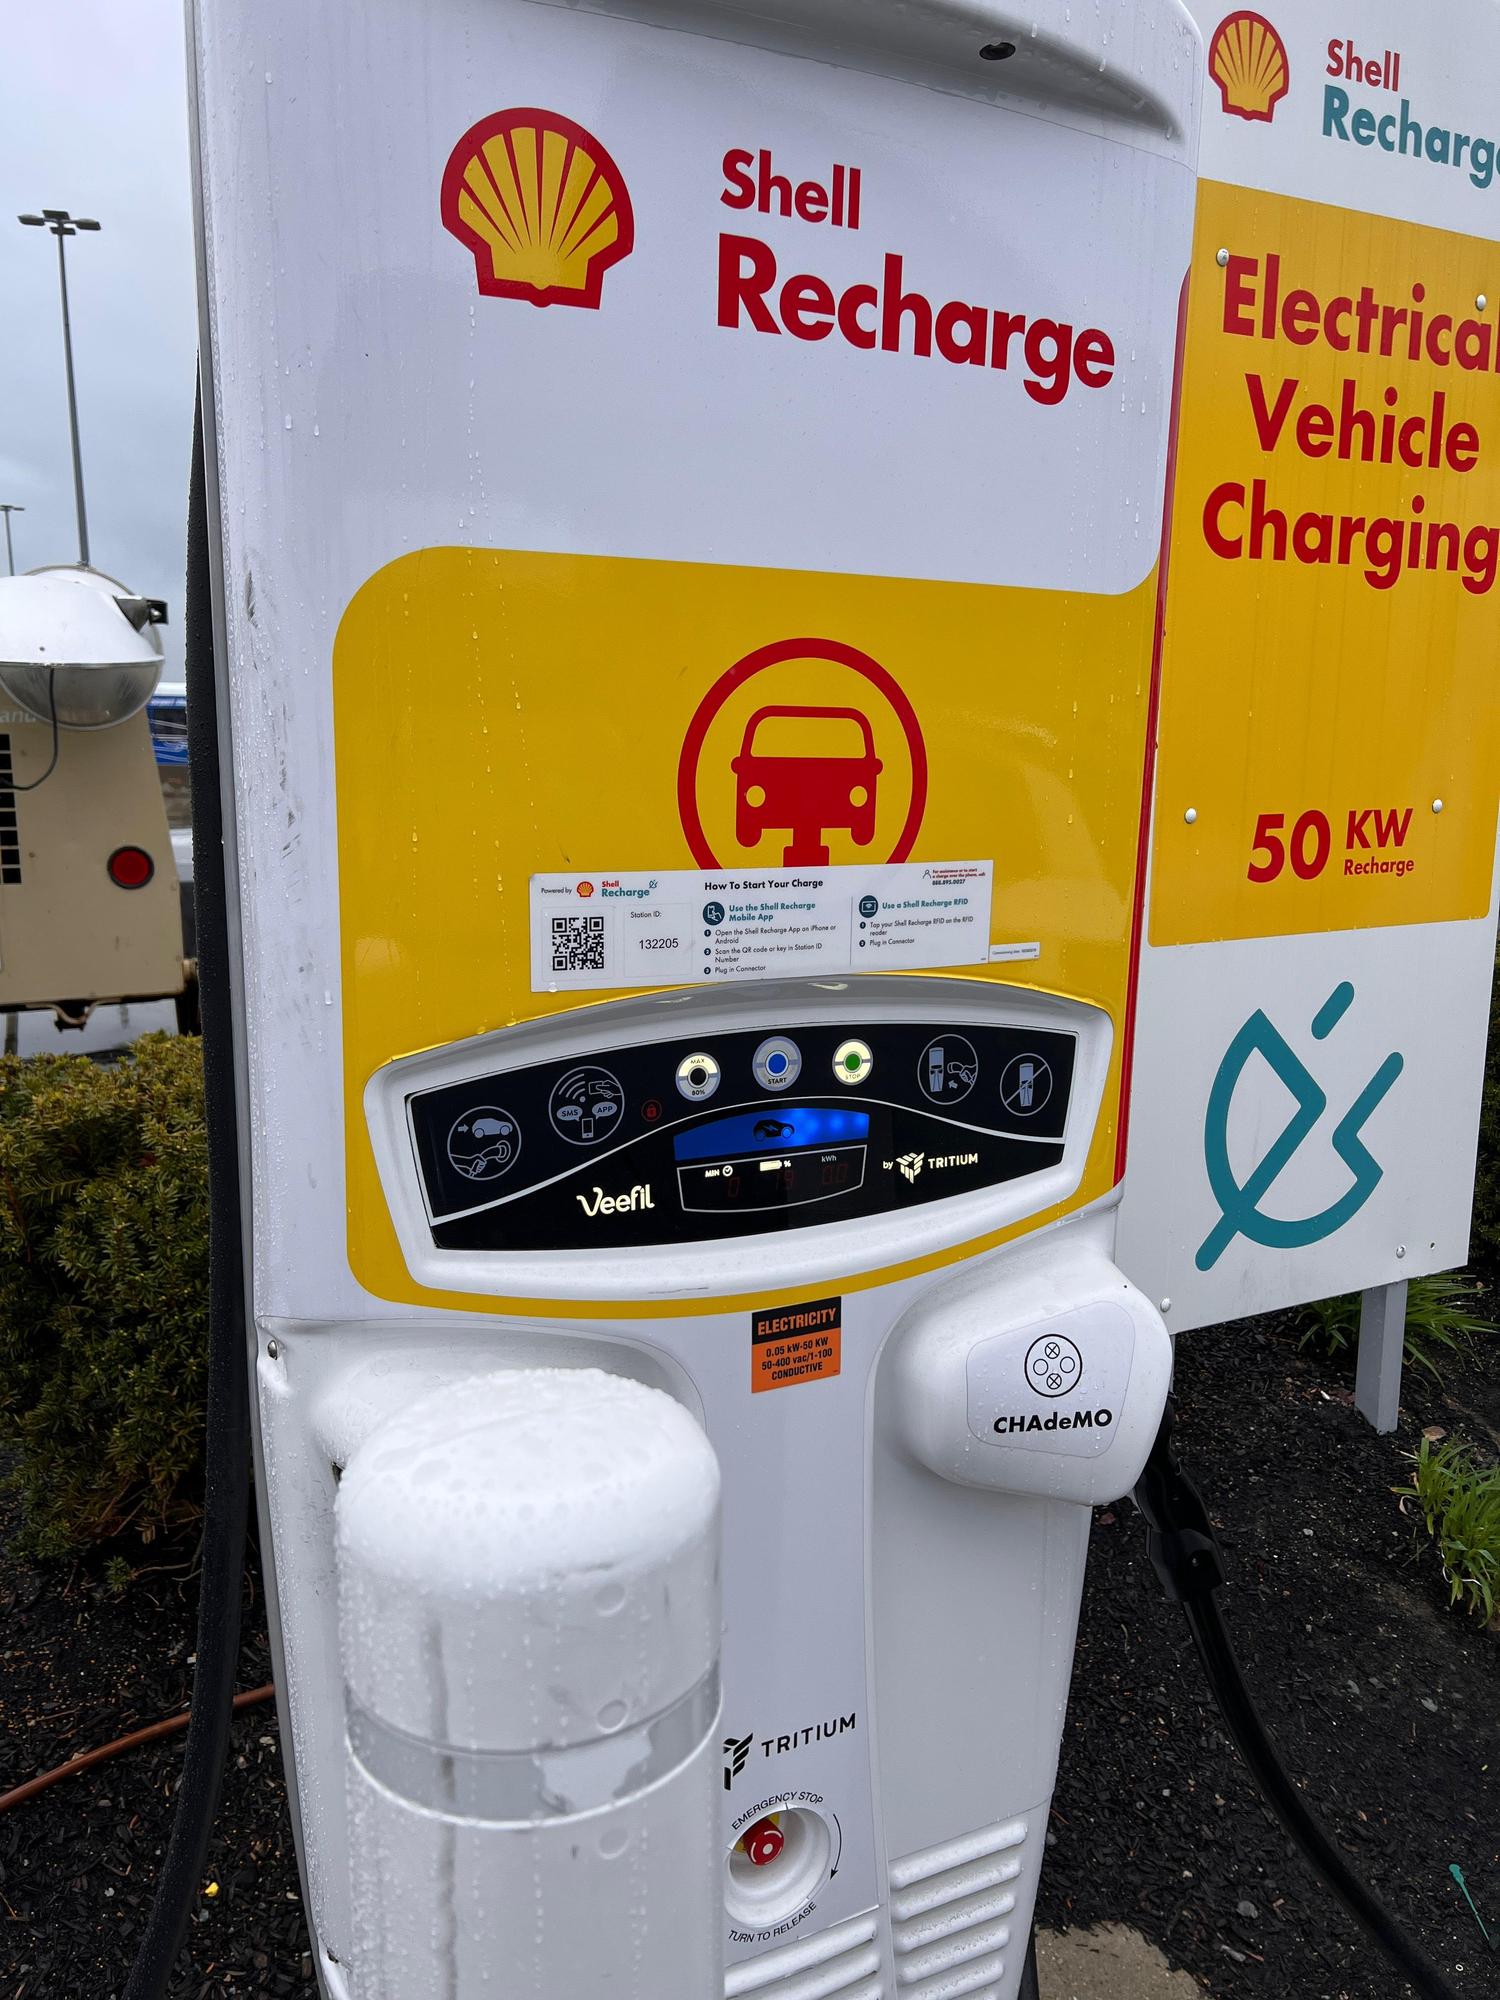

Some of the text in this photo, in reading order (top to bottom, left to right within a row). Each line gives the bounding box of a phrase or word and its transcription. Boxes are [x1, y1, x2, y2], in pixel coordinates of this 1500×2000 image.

[1326, 38, 1400, 92] Shell
[1322, 84, 1500, 190] Recharg
[720, 148, 861, 230] Shell
[717, 232, 1115, 406] Recharge
[1244, 372, 1479, 473] Vehicle
[1202, 478, 1500, 595] Charging
[1247, 807, 1414, 883] 50 KW
[1343, 855, 1415, 877] Recharge
[704, 878, 824, 891] How To Start Your Charge
[541, 887, 562, 895] Powered
[601, 888, 650, 899] Recharge
[760, 903, 778, 911] Shell
[780, 902, 816, 911] Recharge
[882, 902, 896, 910] Use
[902, 901, 920, 909] Shell
[920, 900, 952, 909] Recharge
[954, 898, 968, 906] RFID
[631, 910, 663, 918] Station ID:
[729, 913, 774, 924] Mobile App
[870, 922, 880, 930] Tap
[908, 919, 932, 928] Recharge
[715, 930, 732, 938] Open
[760, 927, 788, 936] Recharge
[788, 926, 800, 935] App
[640, 938, 679, 950] 132205
[870, 940, 881, 948] Plug
[888, 938, 914, 946] Connector
[715, 948, 730, 956] Scan
[752, 946, 768, 954] code
[776, 945, 786, 954] key
[794, 944, 814, 952] Station
[715, 966, 728, 975] Plug
[767, 1077, 787, 1085] START
[692, 1088, 706, 1096] 80%
[596, 1106, 613, 1114] APP
[784, 1160, 791, 1168] %
[822, 1154, 837, 1163] kWh
[928, 1152, 978, 1169] TRITIUM
[882, 1161, 894, 1170] by
[705, 1169, 720, 1178] MIN
[576, 1184, 655, 1217] Veefil
[757, 1307, 836, 1336] ELECTRICITY
[766, 1336, 829, 1358] 0.05 kW-50 KW
[761, 1356, 790, 1371] 50-400
[772, 1362, 823, 1381] CONDUCTIVE
[993, 1408, 1113, 1434] CHAdeMO
[761, 1712, 856, 1758] TRITIUM
[731, 1791, 824, 1831] EMERGENCY STOP
[728, 1901, 818, 1944] TURN TO RELEASE
